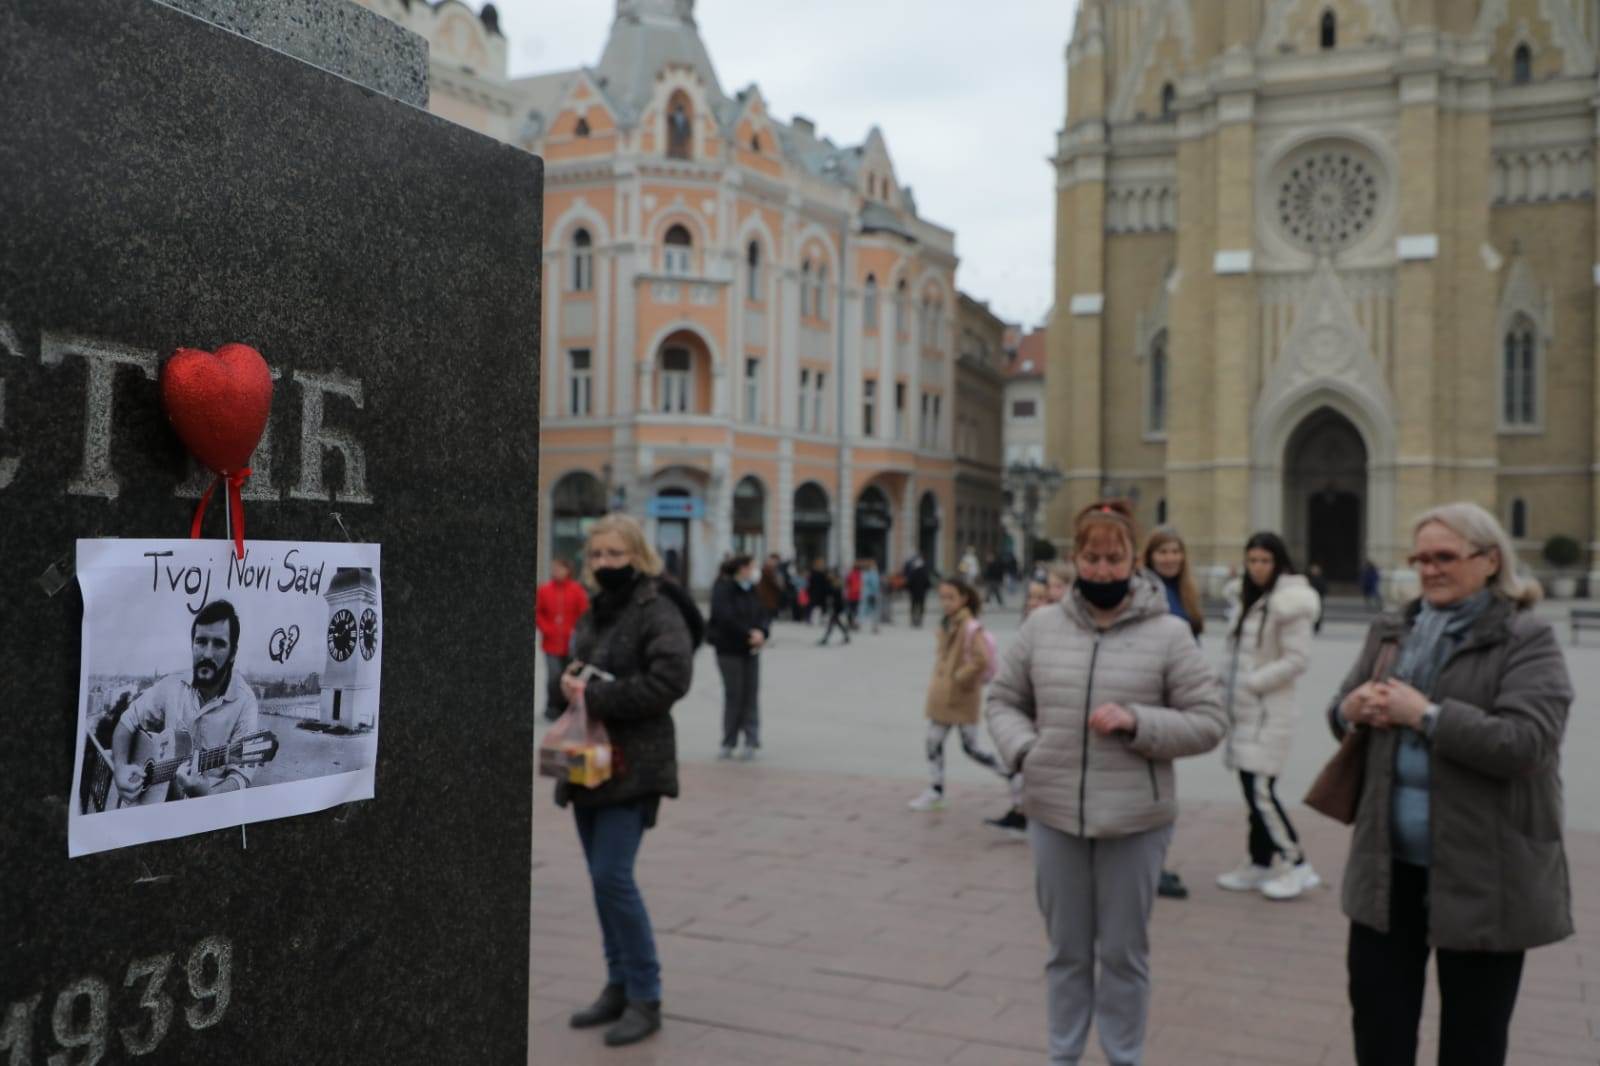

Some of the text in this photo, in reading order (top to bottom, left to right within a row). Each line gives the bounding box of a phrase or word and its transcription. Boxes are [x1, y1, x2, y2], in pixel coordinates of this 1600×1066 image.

[144, 548, 326, 615] Tvoj Novi Sad
